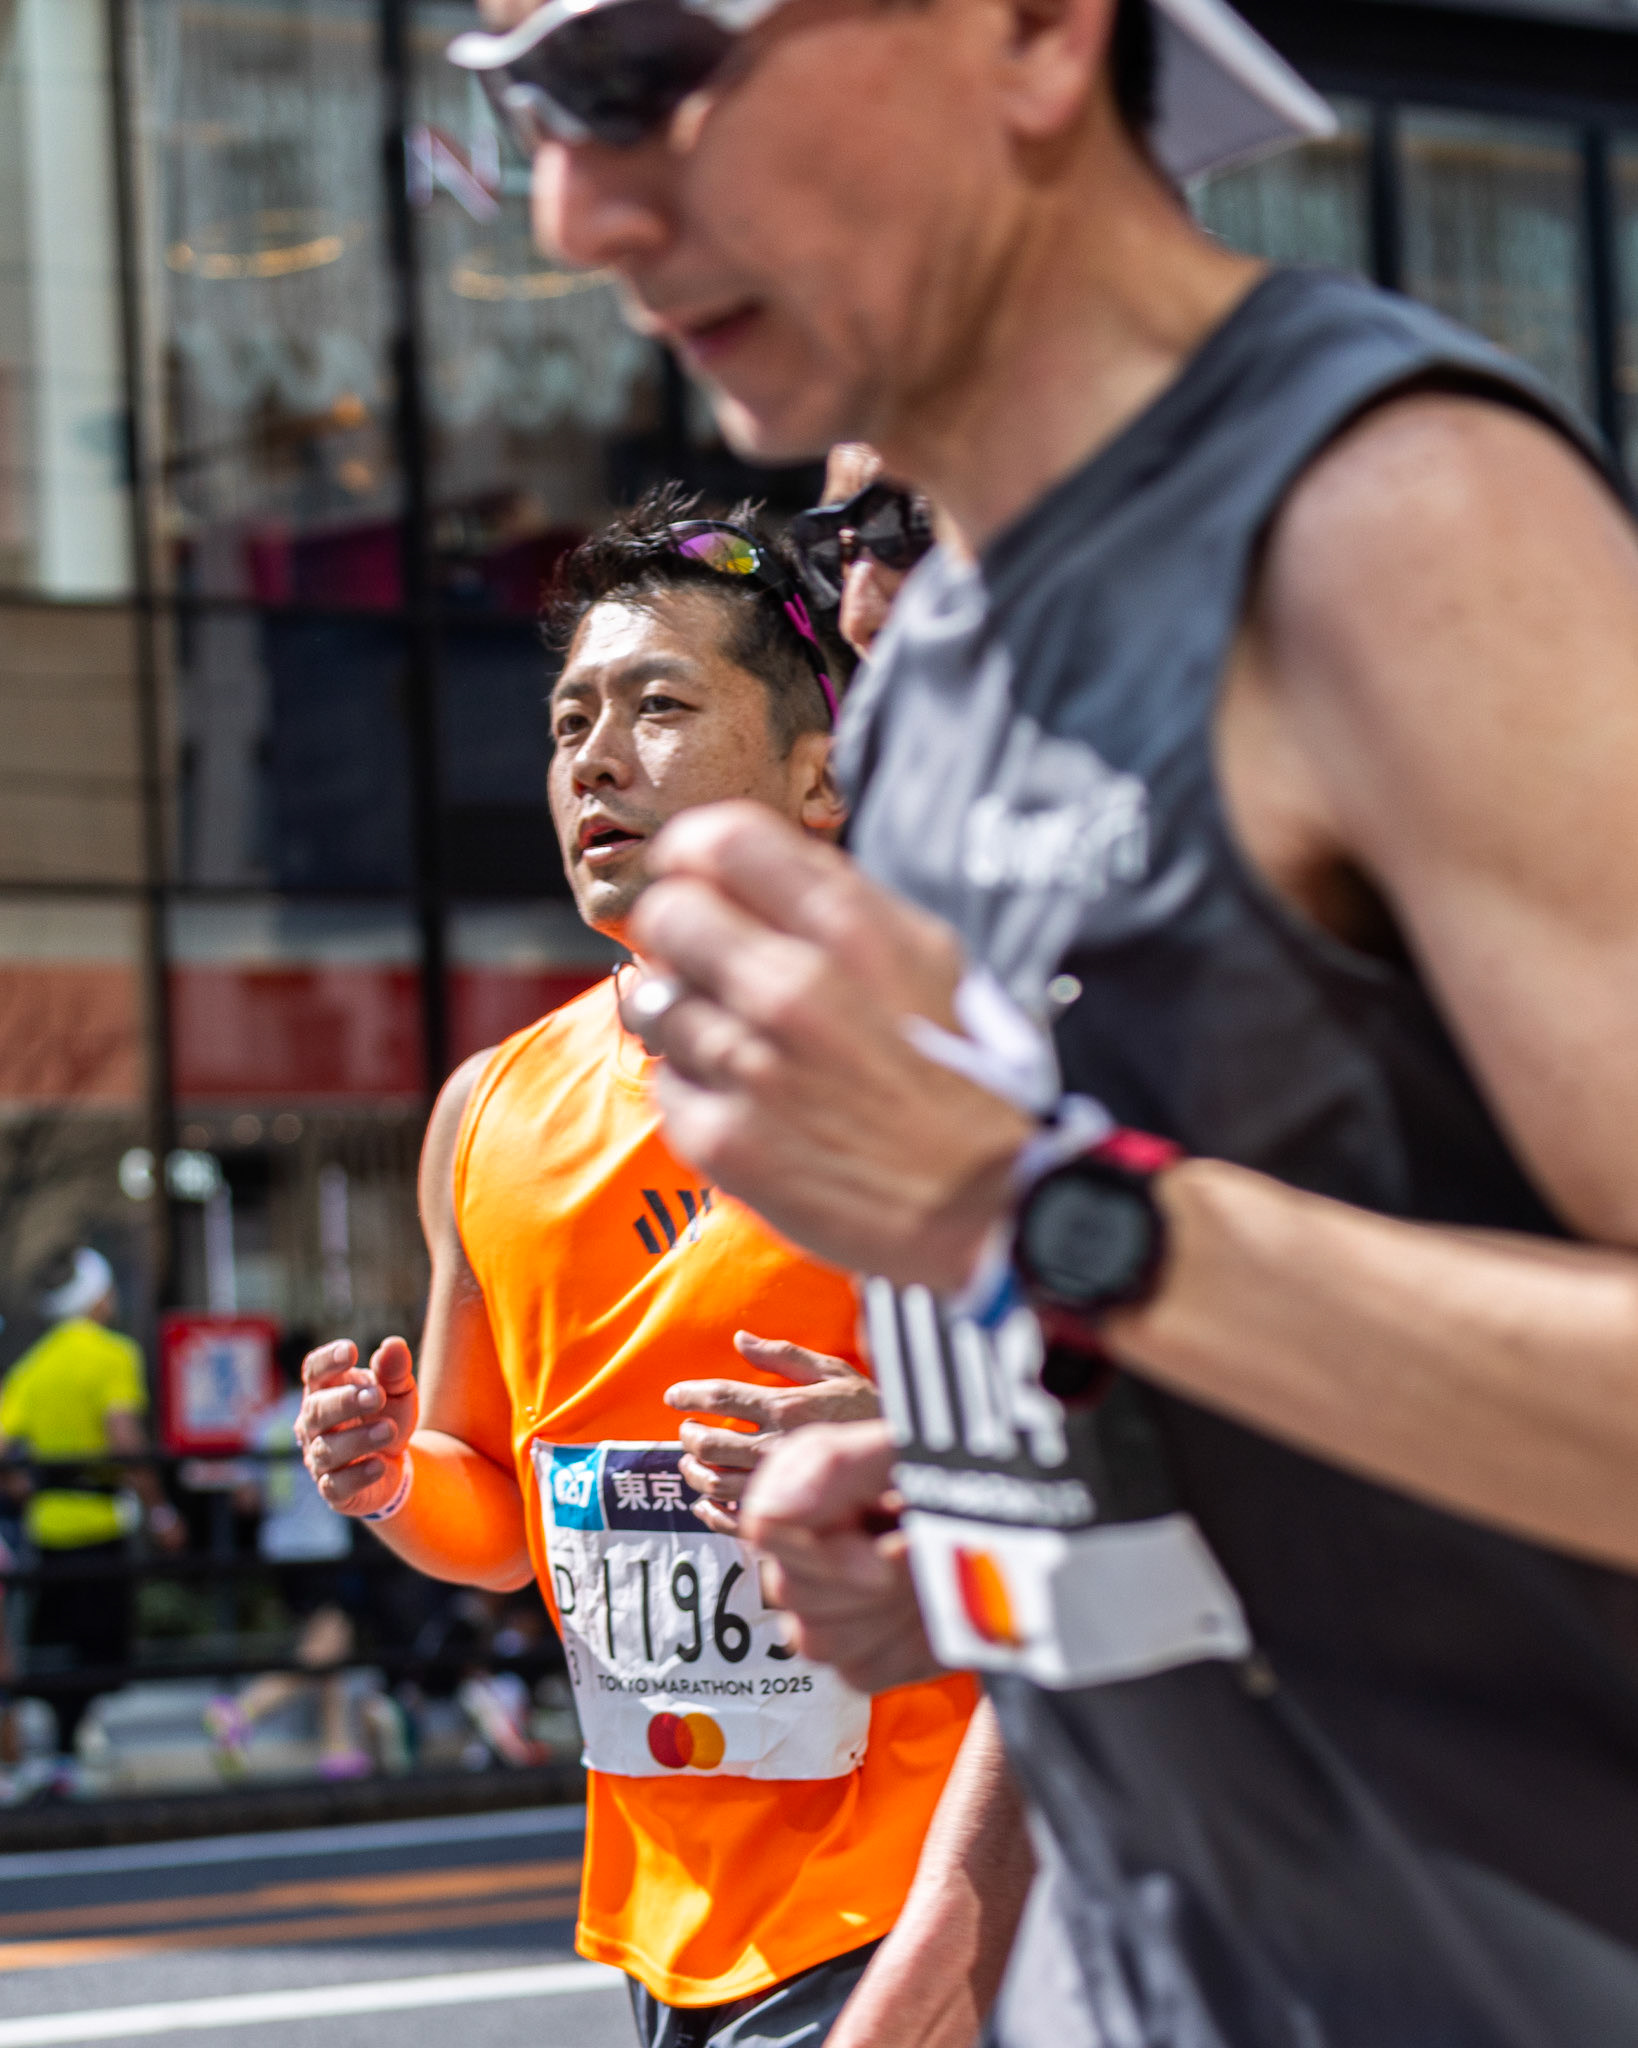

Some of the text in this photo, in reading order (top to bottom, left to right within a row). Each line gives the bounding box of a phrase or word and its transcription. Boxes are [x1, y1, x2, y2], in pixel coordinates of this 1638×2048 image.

[611, 1469, 695, 1512] 東京
[597, 1673, 813, 1696] TOKYO MARATHON 2025
